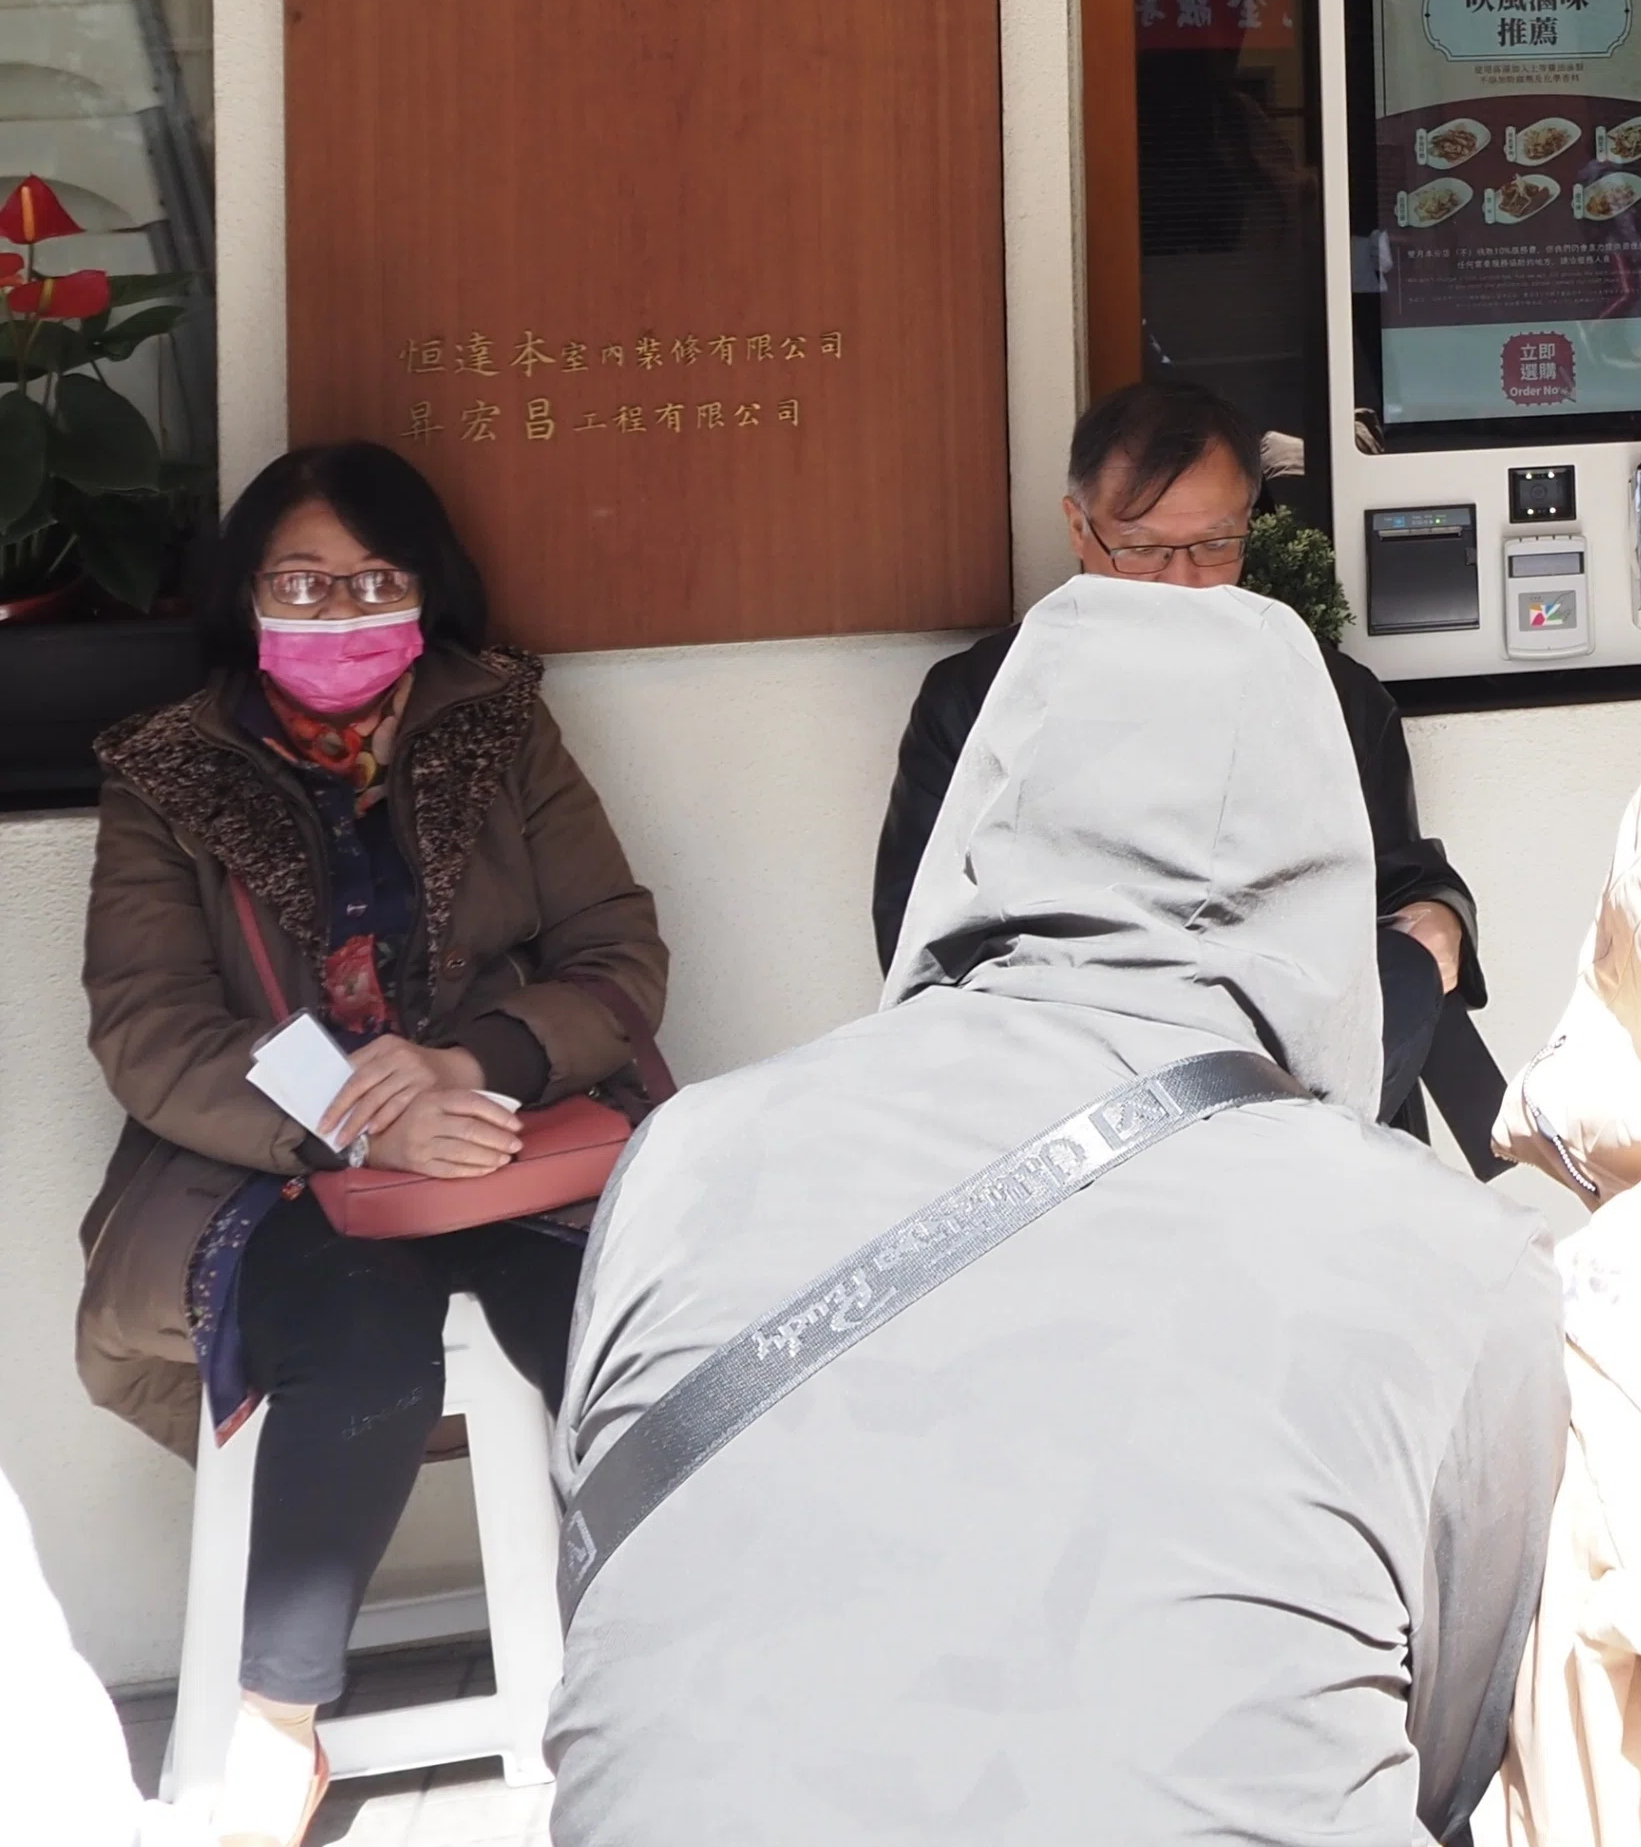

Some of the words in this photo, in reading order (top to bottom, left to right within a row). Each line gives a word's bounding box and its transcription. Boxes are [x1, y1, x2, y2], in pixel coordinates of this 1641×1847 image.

[1497, 15, 1559, 48] 推薦
[1520, 343, 1555, 361] 立即
[1520, 362, 1557, 381] 選購
[1509, 386, 1541, 397] Order
